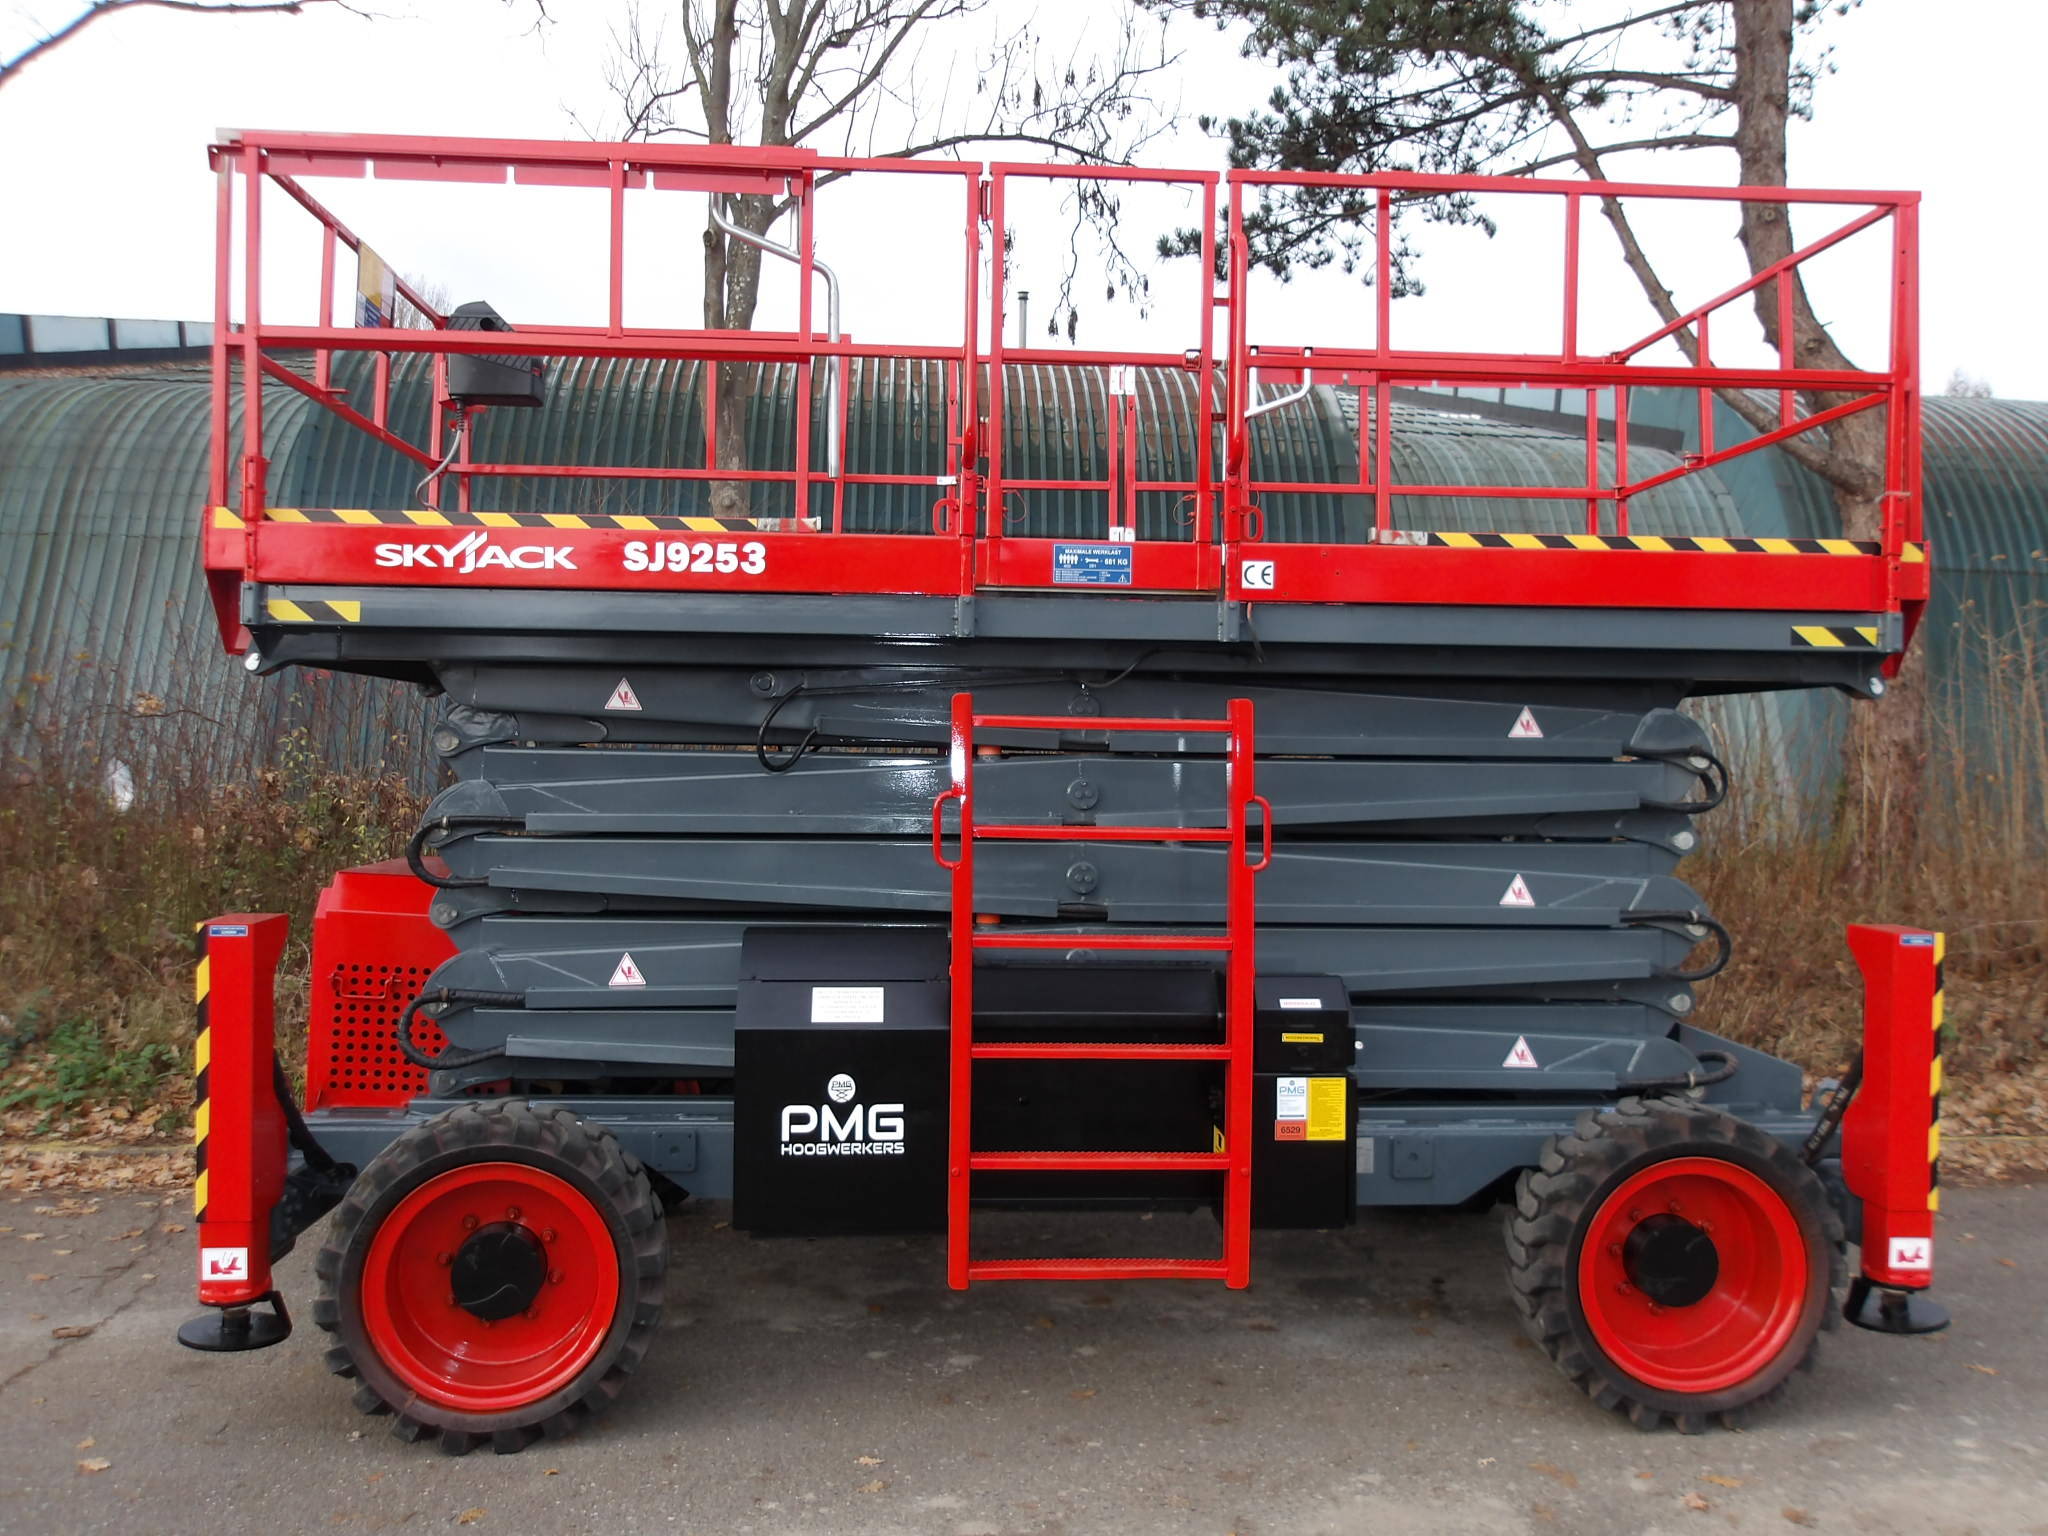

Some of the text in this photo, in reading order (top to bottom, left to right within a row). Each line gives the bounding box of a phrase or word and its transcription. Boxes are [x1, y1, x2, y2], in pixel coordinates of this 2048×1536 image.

[375, 531, 766, 575] SKYJACK SJ9253
[1244, 565, 1272, 585] CE
[1279, 1086, 1305, 1094] PMG
[781, 1103, 904, 1141] PMG
[1280, 1126, 1301, 1134] 6529
[781, 1142, 905, 1156] HOOGWERKERS
